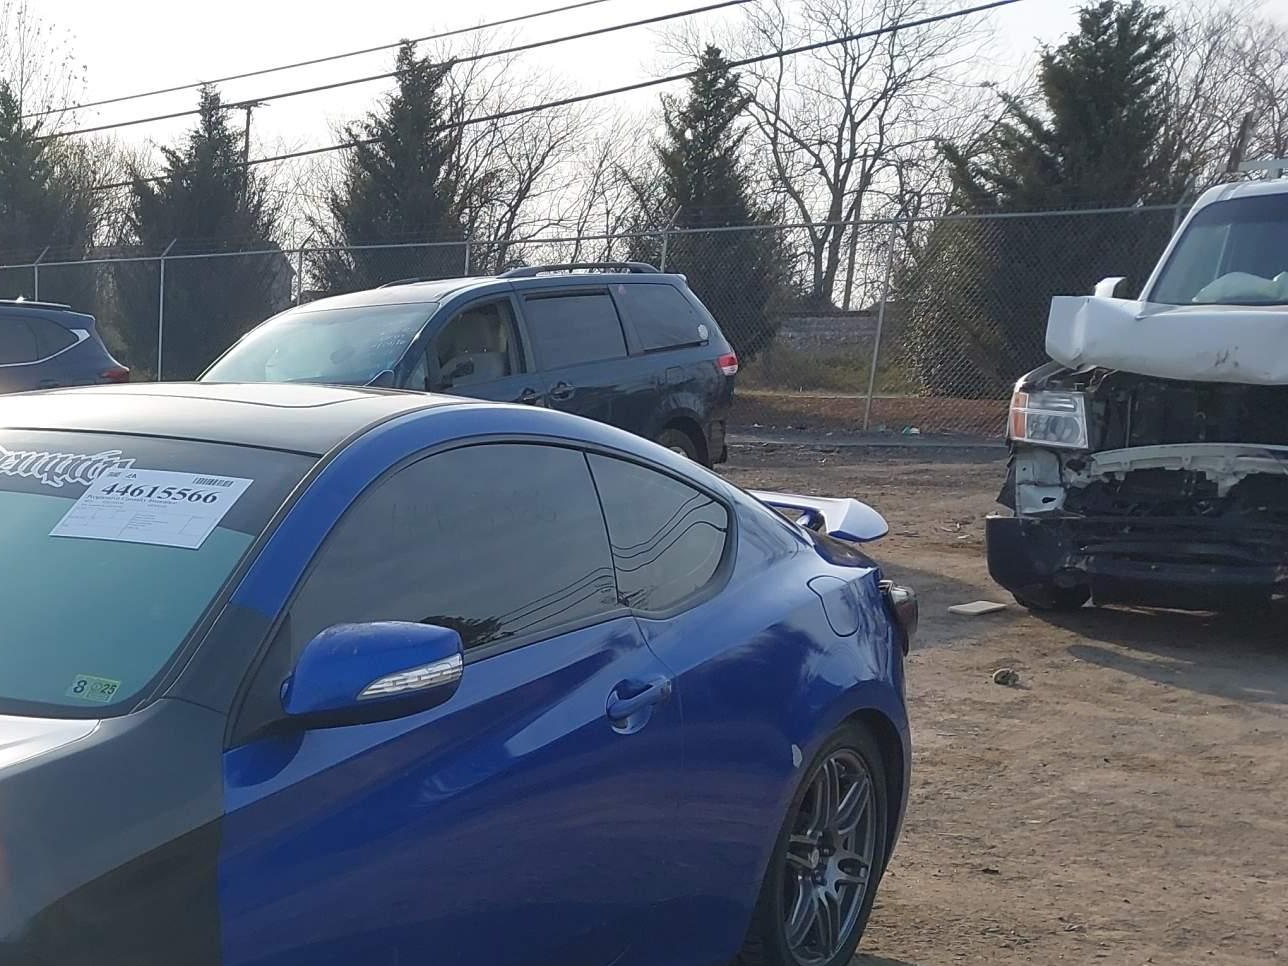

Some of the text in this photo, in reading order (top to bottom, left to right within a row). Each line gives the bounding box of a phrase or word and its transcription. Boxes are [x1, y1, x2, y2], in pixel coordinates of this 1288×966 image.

[101, 482, 222, 504] 44615566
[73, 679, 118, 695] 8 25
